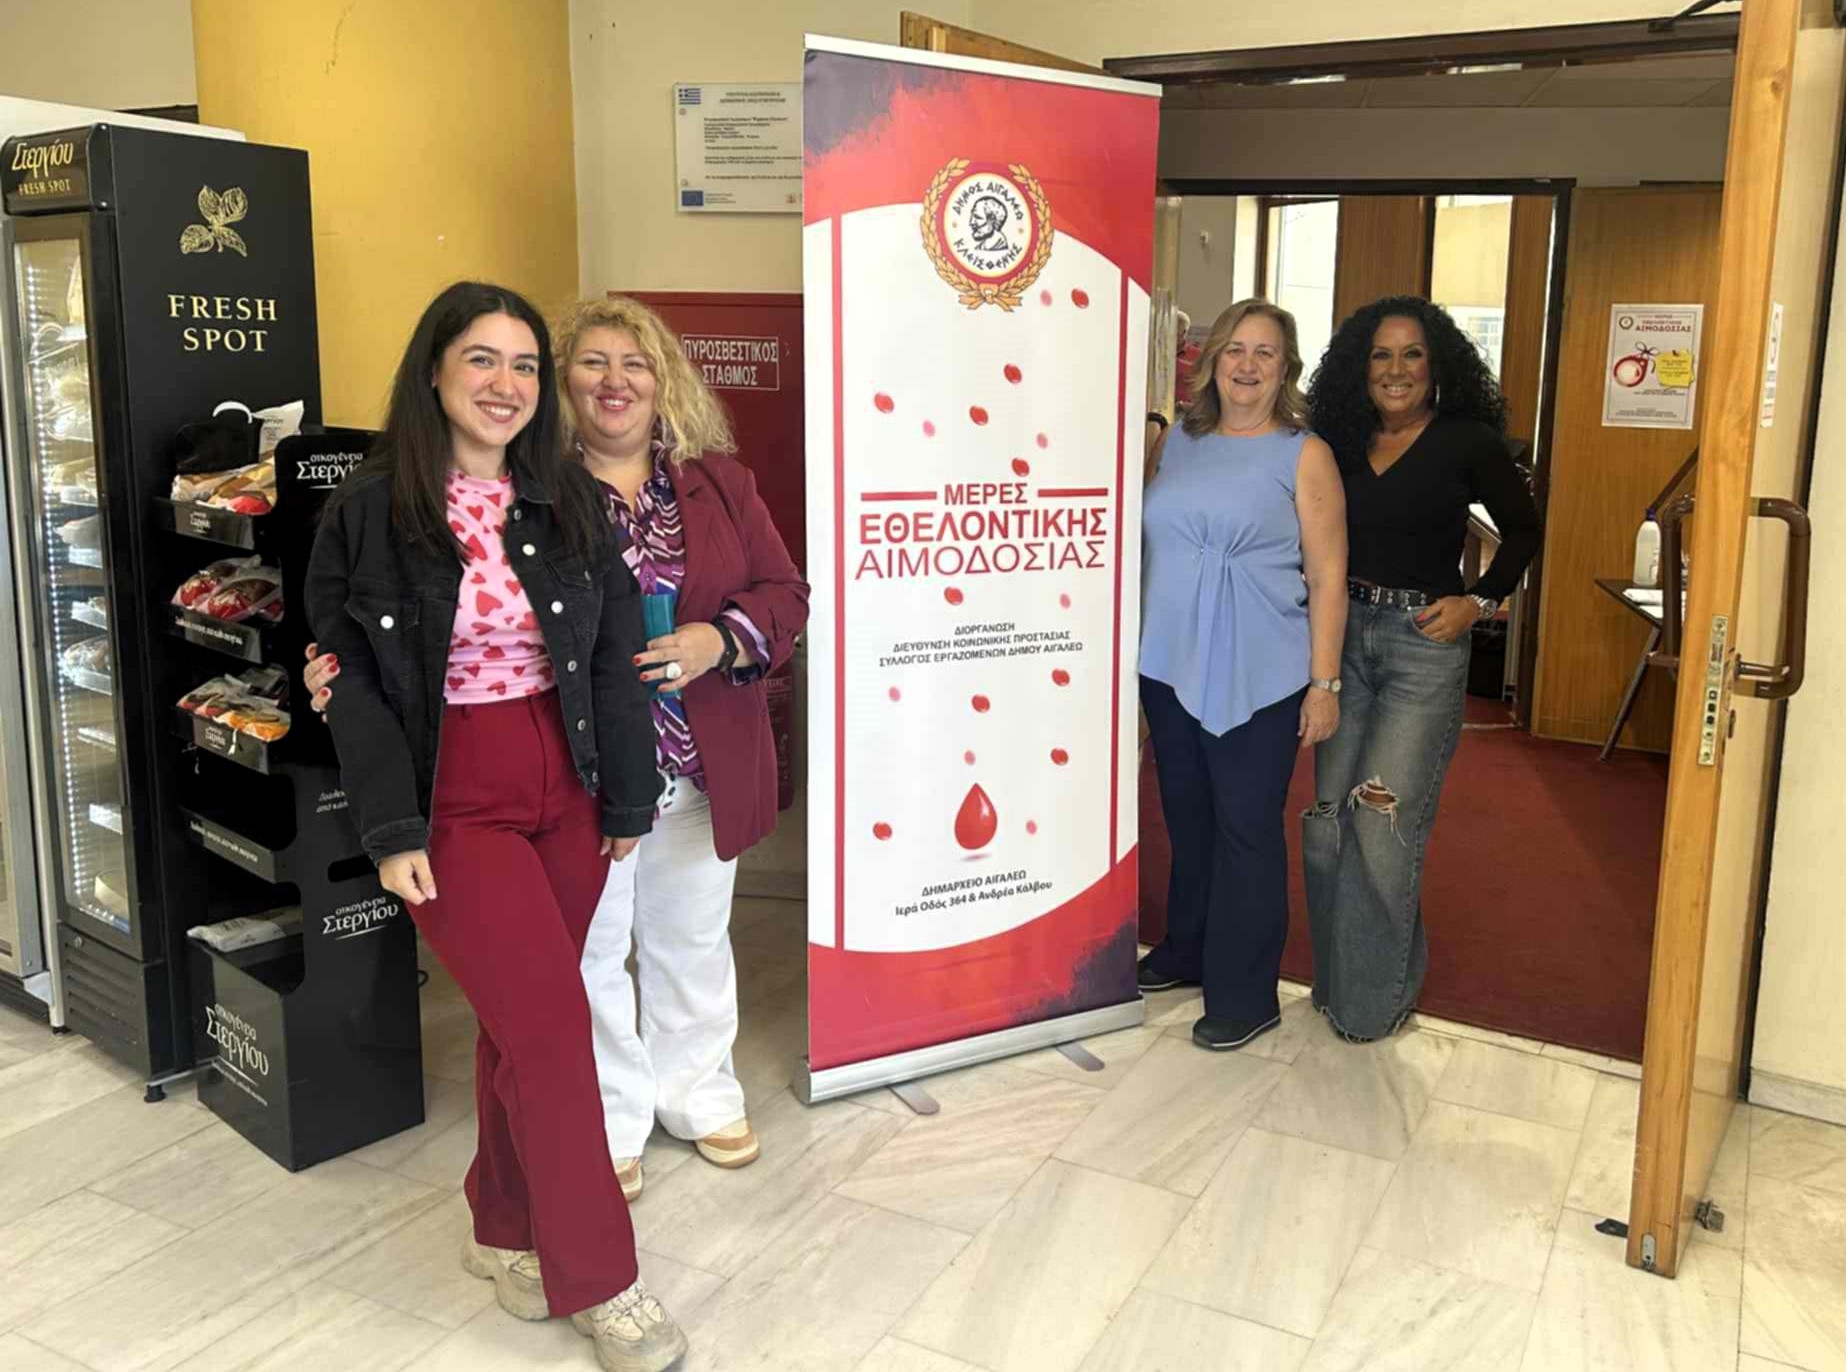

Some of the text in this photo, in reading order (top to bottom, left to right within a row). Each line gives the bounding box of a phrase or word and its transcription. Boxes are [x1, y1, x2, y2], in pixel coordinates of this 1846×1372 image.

[11, 138, 74, 179] Στεργίου
[19, 179, 71, 196] FRESH SPOT
[952, 181, 984, 215] ΔΗΜΟΣ
[167, 294, 278, 321] FRESH
[183, 327, 268, 352] SPOT
[684, 339, 778, 362] ΠΥΡΟΣΒΕΣΤΙΚΟΣ
[702, 364, 758, 386] ΣΤΑΘΜΟΣ
[944, 482, 1028, 506] ΜΕΡΕΣ
[860, 507, 1107, 544] ΕΘΕΛΟΝΤΙΚΗΣ
[855, 540, 1105, 580] ΑΙΜΟΔΟΣΙΑΣ
[893, 630, 1071, 653] ΔΙΕΥΘΥΝΣΗ ΚΟΙΝΩΝΙΚΗΣ ΠΡΟΣΤΑΣΙΑΣ
[954, 622, 1015, 636] ΔΙΟΡΓΑΝΩΣΗ
[879, 641, 1083, 668] ΣΥΛΛΟΓΟΣ ΕΡΓΑΖΟΜΕΝΩΝ ΔΗΜΟΥ ΑΙΓΑΛΕΩ
[922, 870, 1027, 897] ΔΗΜΑΡΧΕΙΟ ΑΙΓΑΛΕΩ
[895, 880, 1053, 917] Ιερά Οδός 364 & Ανδρέα Κάλβου
[323, 904, 399, 934] Στεργίου
[205, 1006, 269, 1076] Στεργίου
